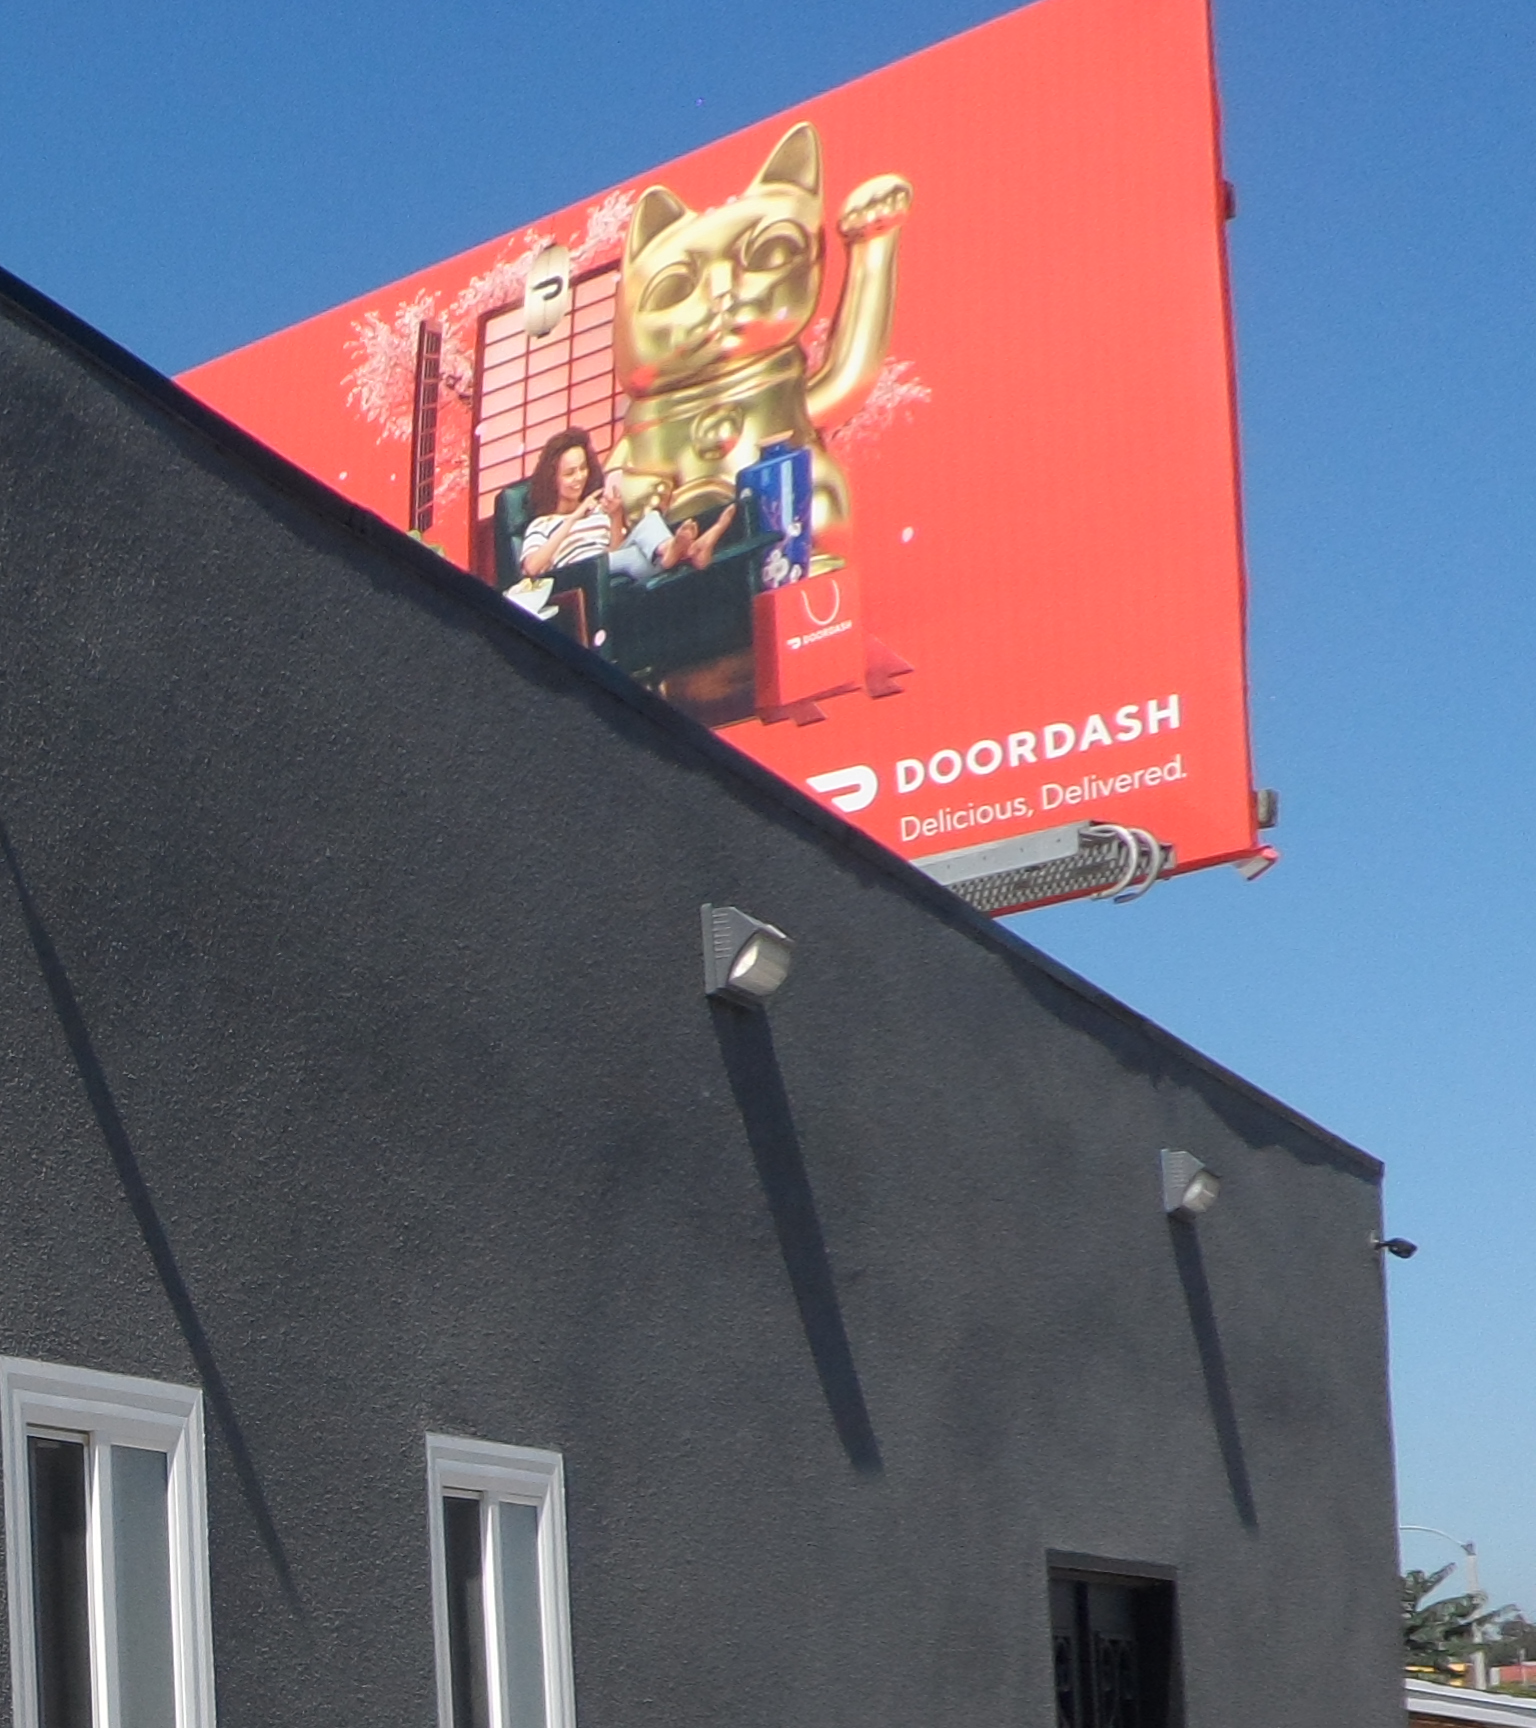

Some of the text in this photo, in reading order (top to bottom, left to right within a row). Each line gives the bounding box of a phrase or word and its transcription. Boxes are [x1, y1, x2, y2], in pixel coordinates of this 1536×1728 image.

[895, 693, 1181, 794] DOORDASH
[900, 753, 1187, 842] Delicious, Delivered.
